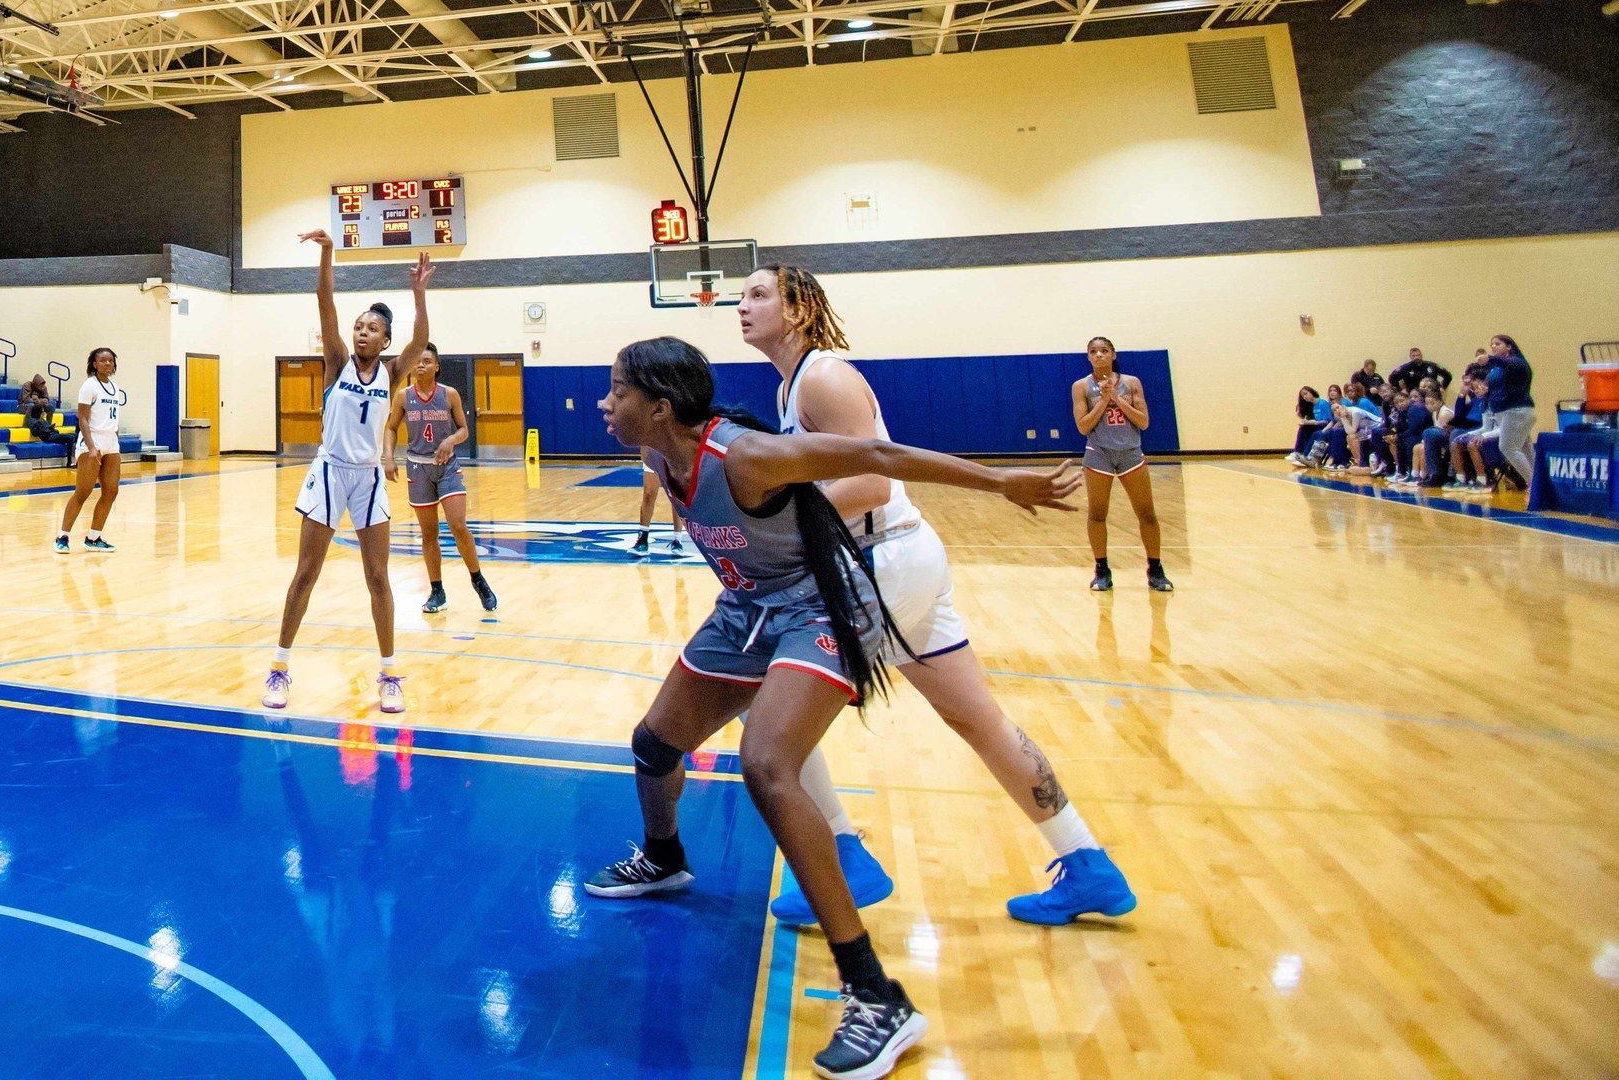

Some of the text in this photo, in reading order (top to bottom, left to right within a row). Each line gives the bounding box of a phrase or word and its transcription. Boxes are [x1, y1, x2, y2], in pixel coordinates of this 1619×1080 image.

[382, 181, 418, 200] 9:20
[439, 190, 455, 207] 11
[342, 195, 362, 212] 23
[411, 205, 419, 219] 2
[386, 210, 406, 218] period
[384, 222, 409, 231] PLAYER
[658, 218, 685, 240] 30
[351, 234, 359, 247] 0
[443, 230, 451, 243] 2
[367, 388, 389, 398] TECH
[359, 400, 370, 424] 1
[1106, 408, 1125, 426] 22
[423, 422, 434, 442] 4
[1549, 456, 1609, 480] WAKE TE
